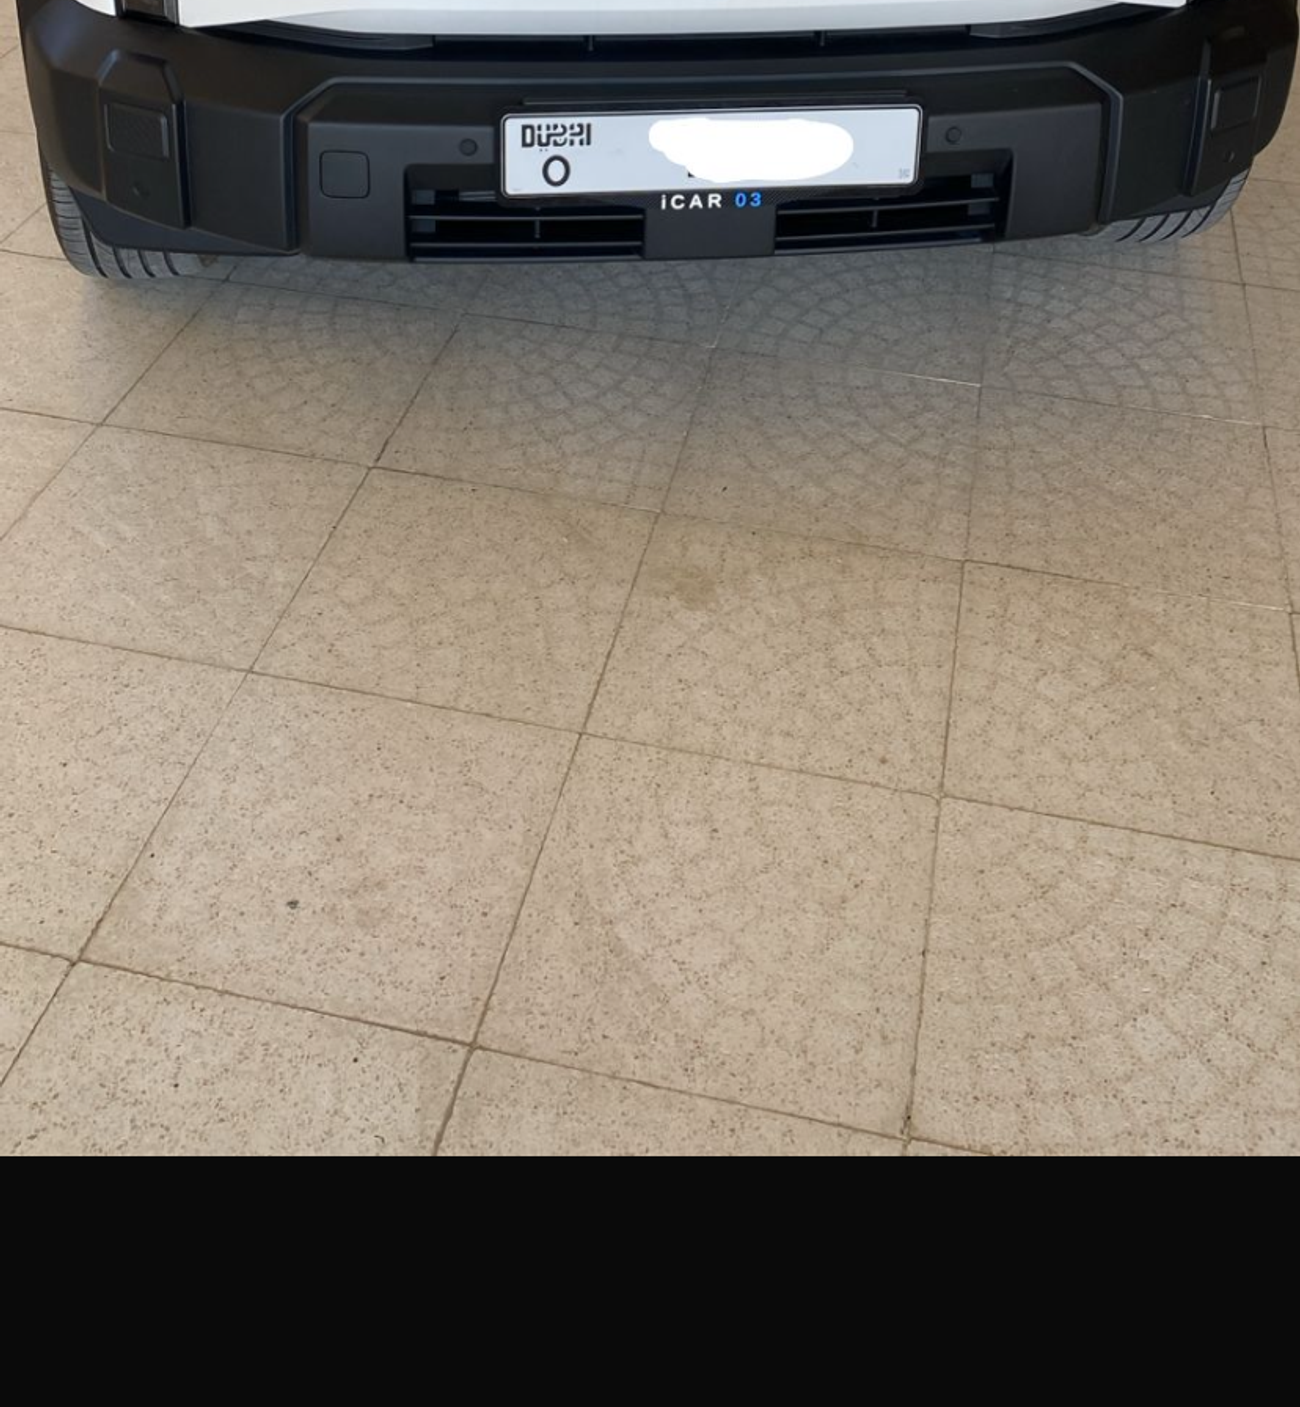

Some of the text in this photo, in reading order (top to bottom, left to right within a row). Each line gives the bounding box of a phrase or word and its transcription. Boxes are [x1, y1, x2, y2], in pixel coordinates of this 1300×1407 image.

[521, 122, 592, 148] DUBAI
[542, 154, 570, 187] O
[661, 192, 761, 210] iCAR 03
